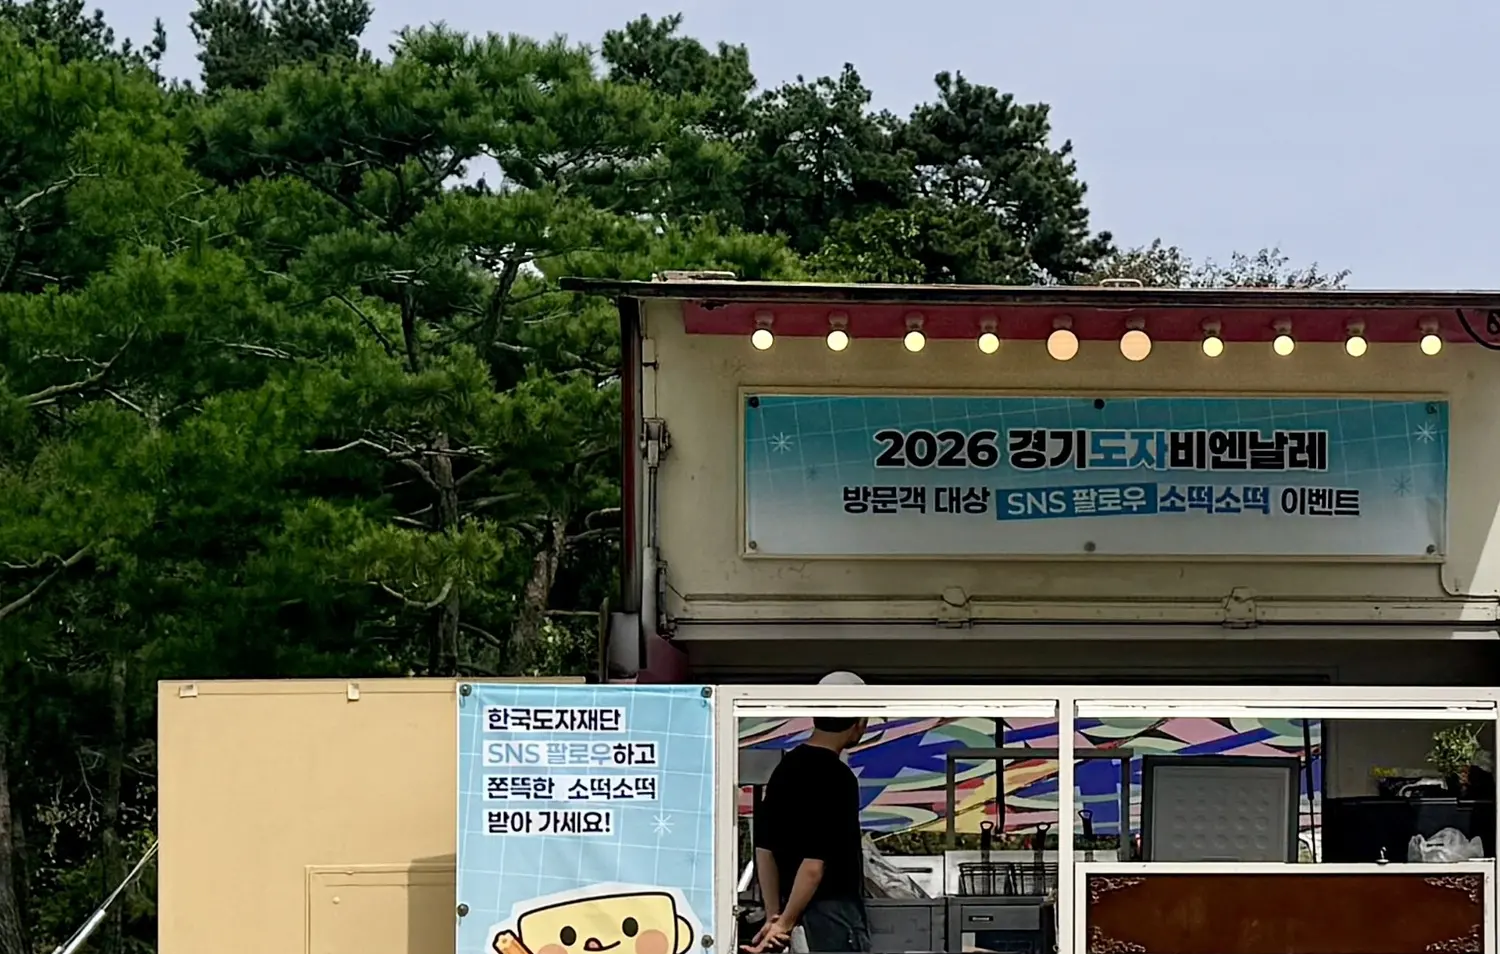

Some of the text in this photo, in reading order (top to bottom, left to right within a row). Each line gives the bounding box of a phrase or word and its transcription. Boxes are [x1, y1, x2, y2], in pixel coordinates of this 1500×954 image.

[874, 428, 1328, 473] 2026 경기도자비엔날레
[842, 486, 1360, 517] 방문객 대상 SNS 팔로우 소떡소떡 이벤트
[488, 708, 621, 731] 한국도자재단
[488, 743, 656, 765] SNS 팔로우하고
[487, 777, 656, 800] 쫀뜩한 소떡소떡
[488, 811, 611, 833] 받아 가세요!
